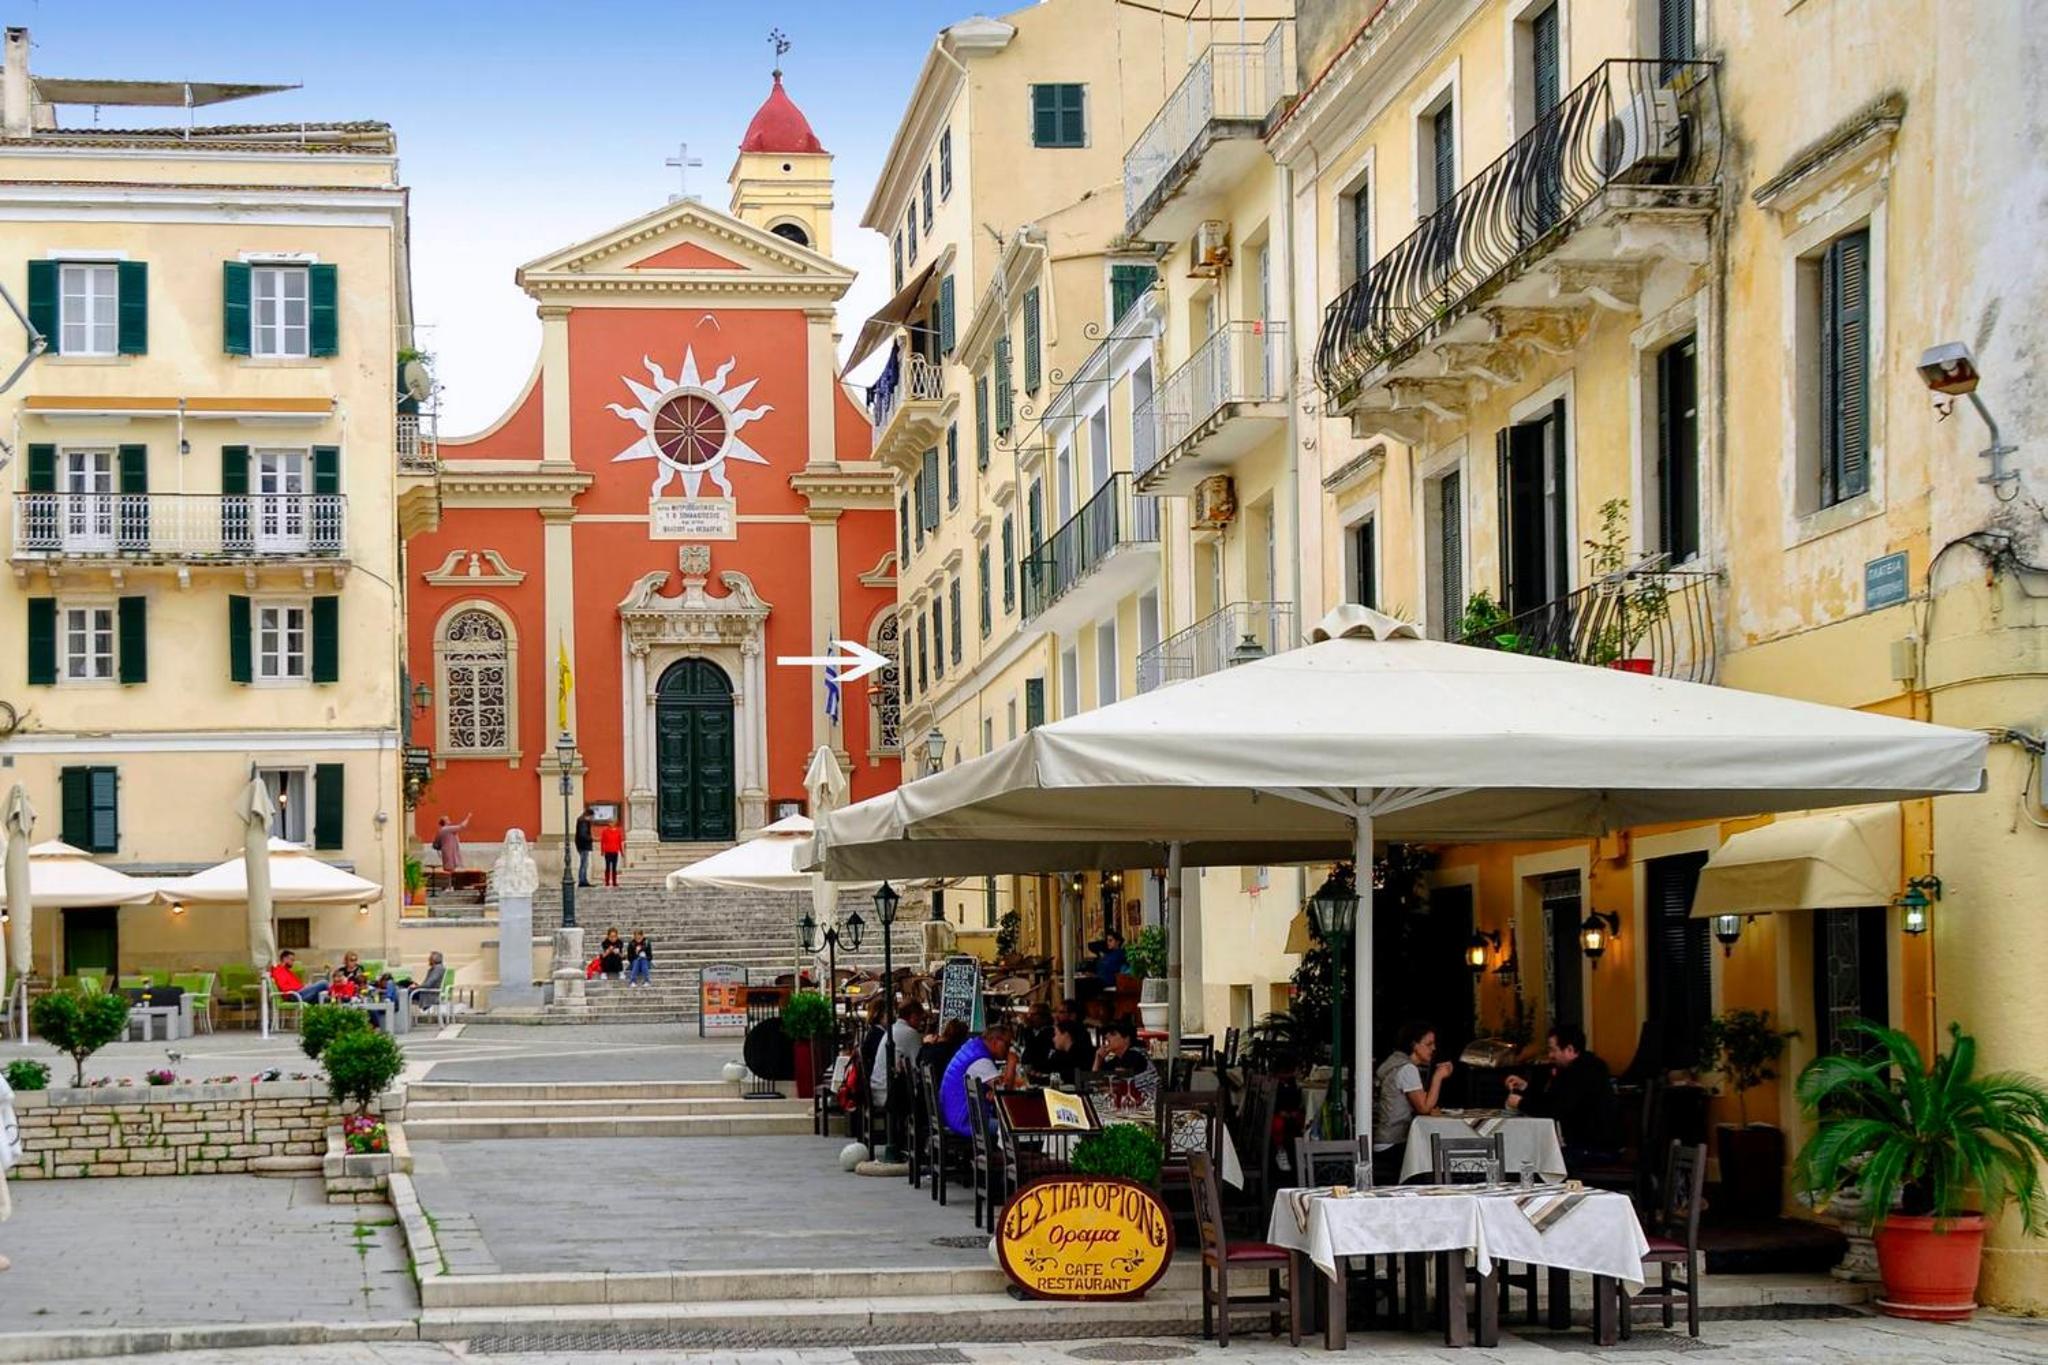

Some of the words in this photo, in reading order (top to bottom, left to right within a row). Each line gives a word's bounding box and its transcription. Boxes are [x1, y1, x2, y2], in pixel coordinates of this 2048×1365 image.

[1007, 1183, 1163, 1247] ΕΣΤΙΑΤΟΡΙΟΝ
[1064, 1262, 1104, 1276] CAFE
[1037, 1276, 1132, 1290] RESTAURANT
